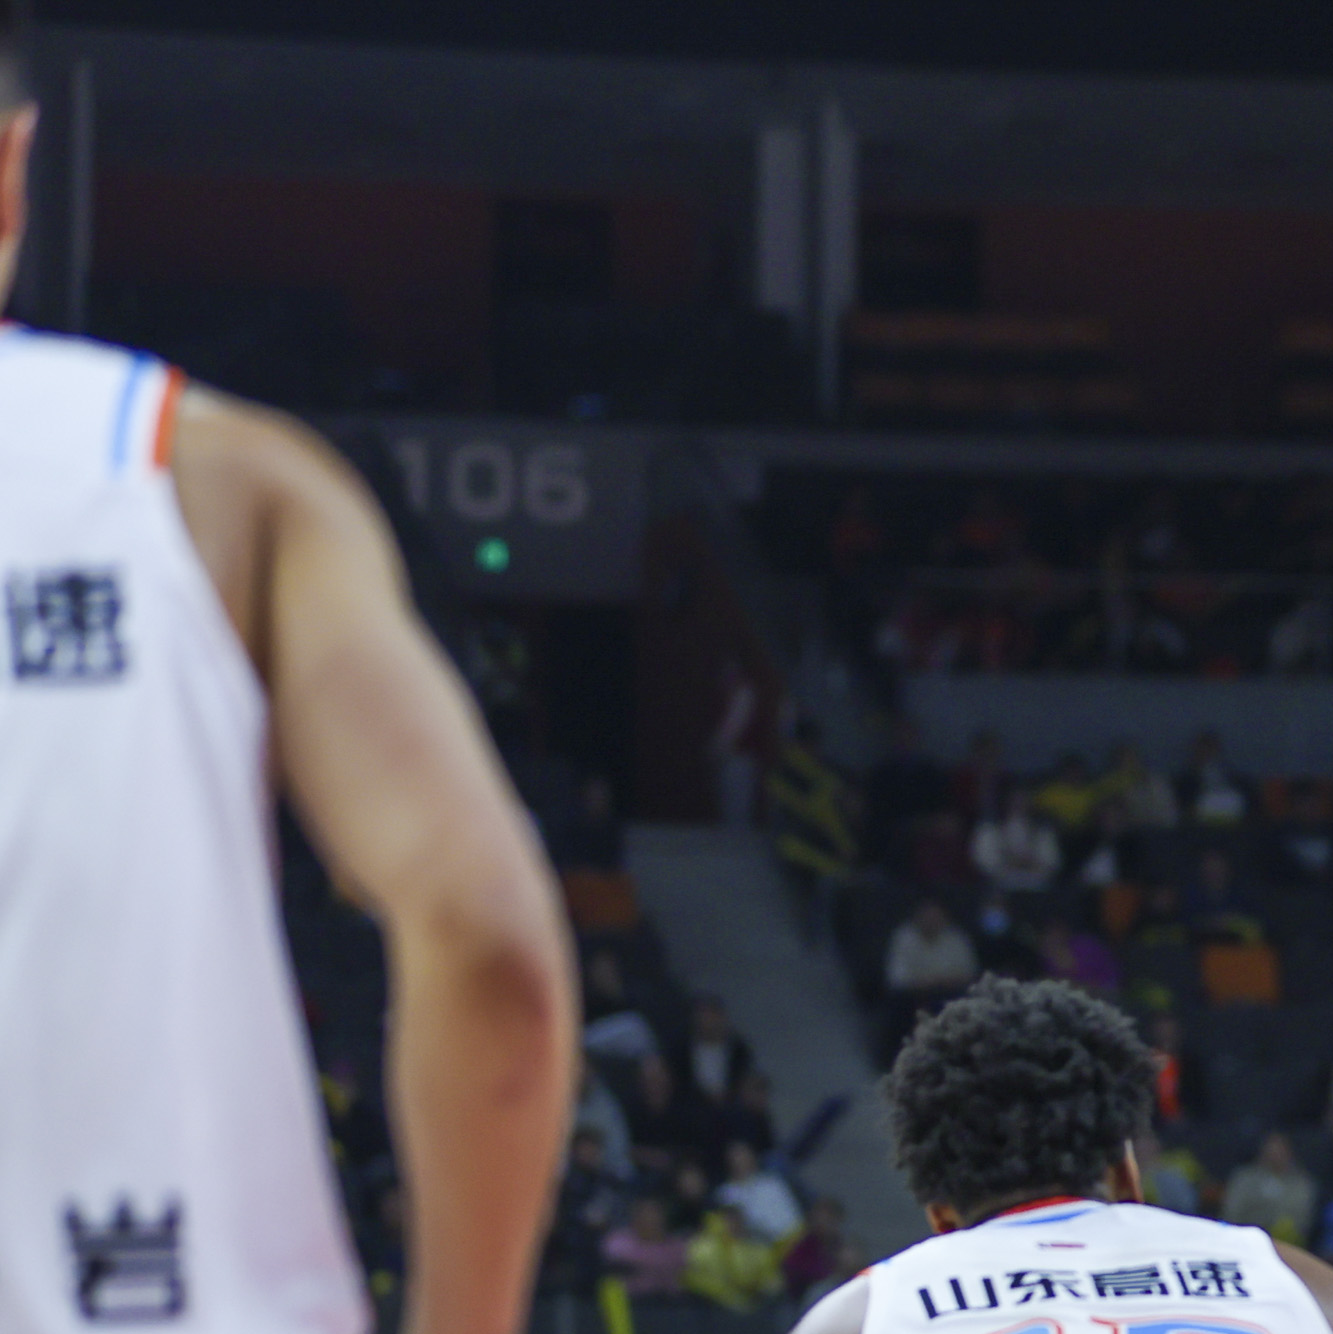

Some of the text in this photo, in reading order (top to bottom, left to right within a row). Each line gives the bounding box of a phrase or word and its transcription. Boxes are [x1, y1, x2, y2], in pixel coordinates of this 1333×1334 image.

[396, 436, 592, 524] 106
[62, 1192, 187, 1323] 岩
[917, 1260, 1250, 1320] 山东高速
